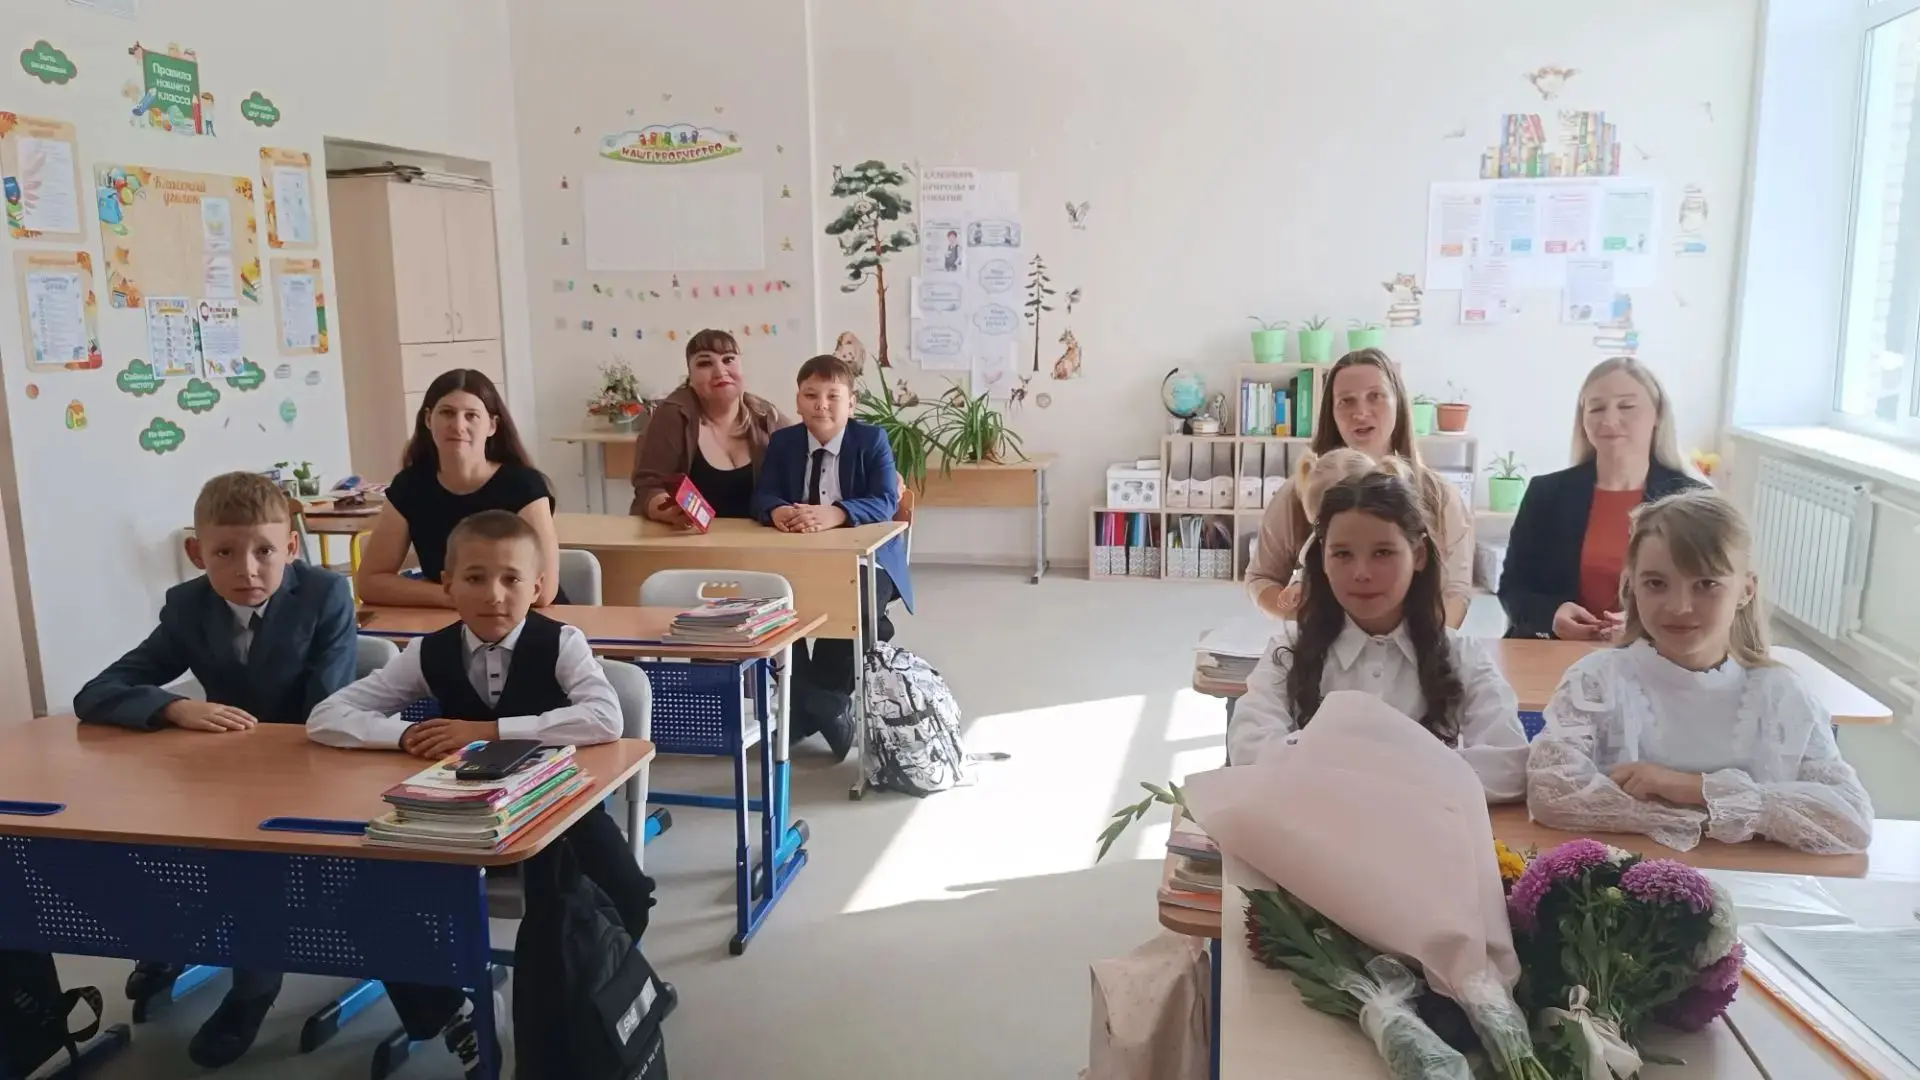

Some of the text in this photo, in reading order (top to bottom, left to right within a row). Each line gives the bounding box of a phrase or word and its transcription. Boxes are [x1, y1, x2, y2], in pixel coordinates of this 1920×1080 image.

[152, 62, 192, 81] Правила
[156, 78, 191, 93] нашего
[157, 91, 191, 106] класса
[621, 142, 723, 161] НАШЕ ТВОРЧЕСТВО
